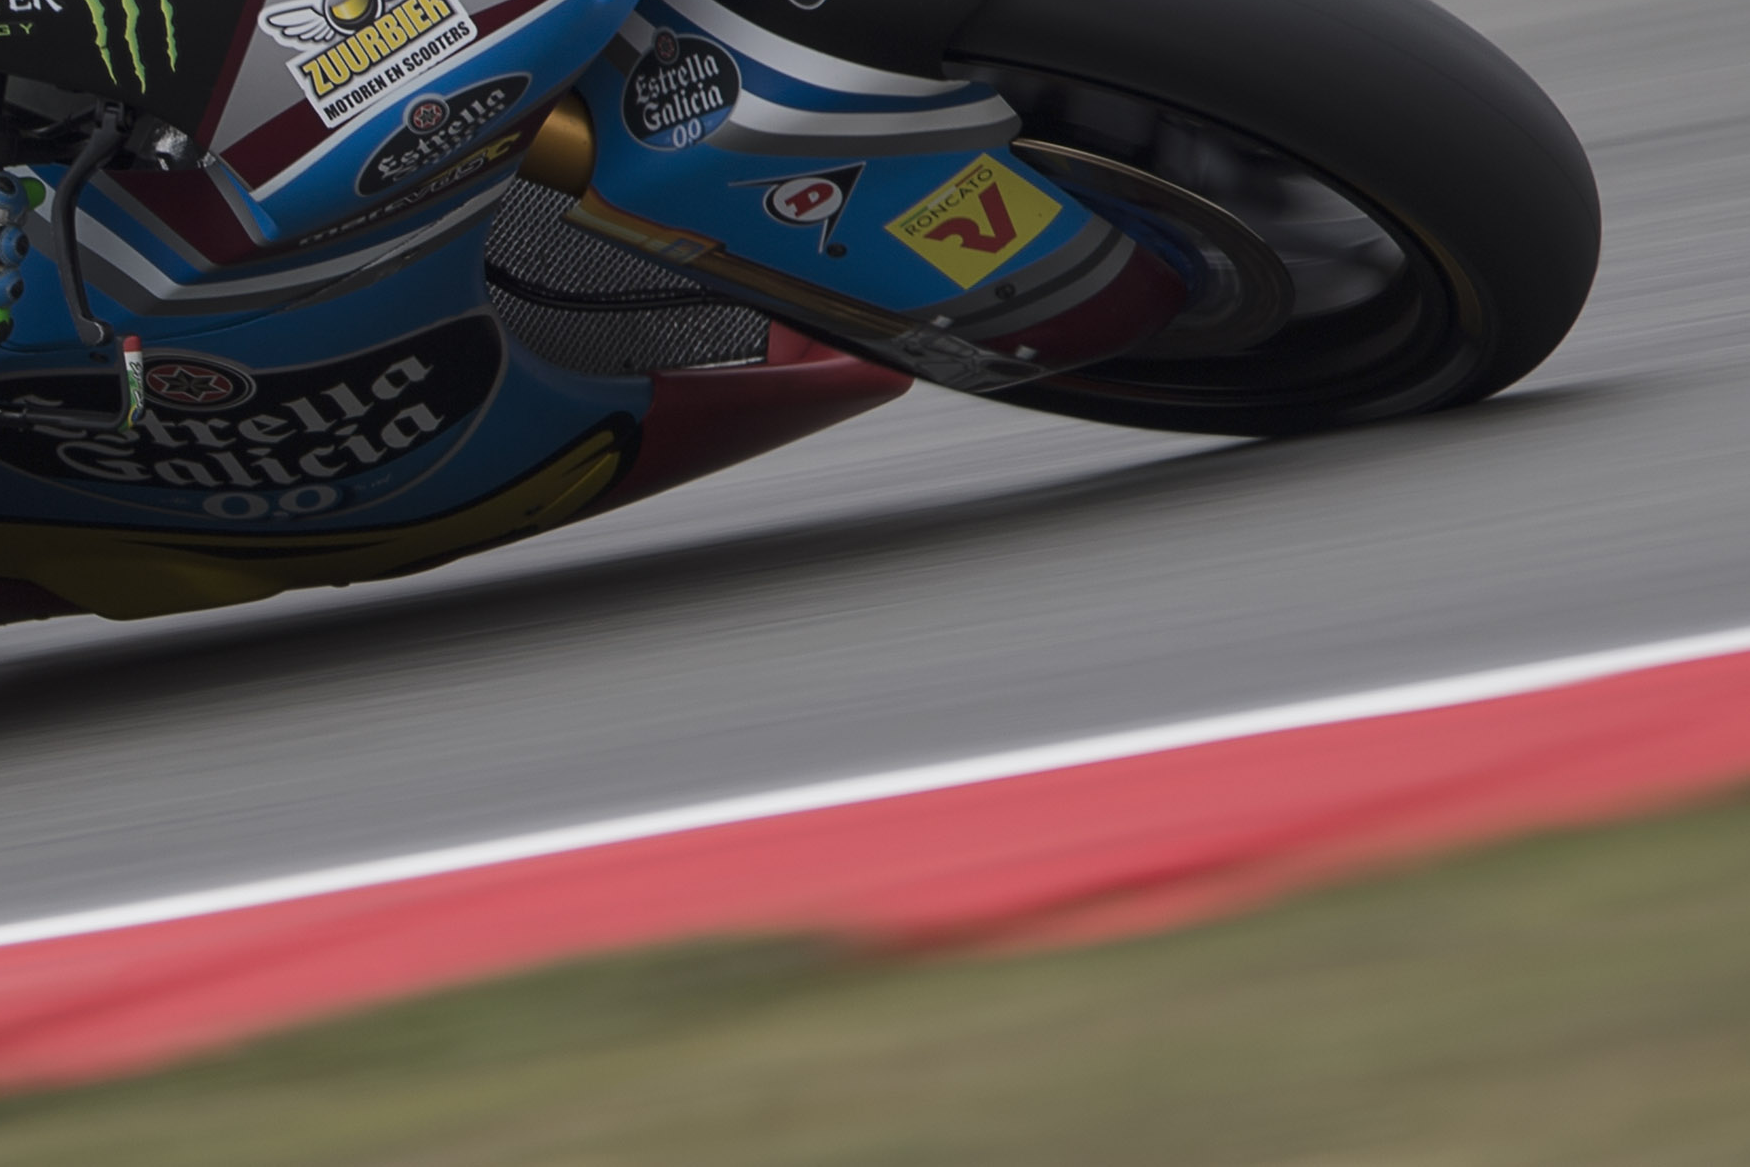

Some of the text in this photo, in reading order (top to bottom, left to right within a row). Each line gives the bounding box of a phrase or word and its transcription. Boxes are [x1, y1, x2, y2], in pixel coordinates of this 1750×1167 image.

[323, 20, 471, 122] MOTOREN EN SCOOTERS
[635, 52, 720, 106] Estrella
[642, 81, 724, 132] Galicia
[376, 88, 506, 180] Estrella
[904, 167, 994, 237] RONCATO
[12, 355, 434, 449] trella
[56, 403, 444, 488] Galicia
